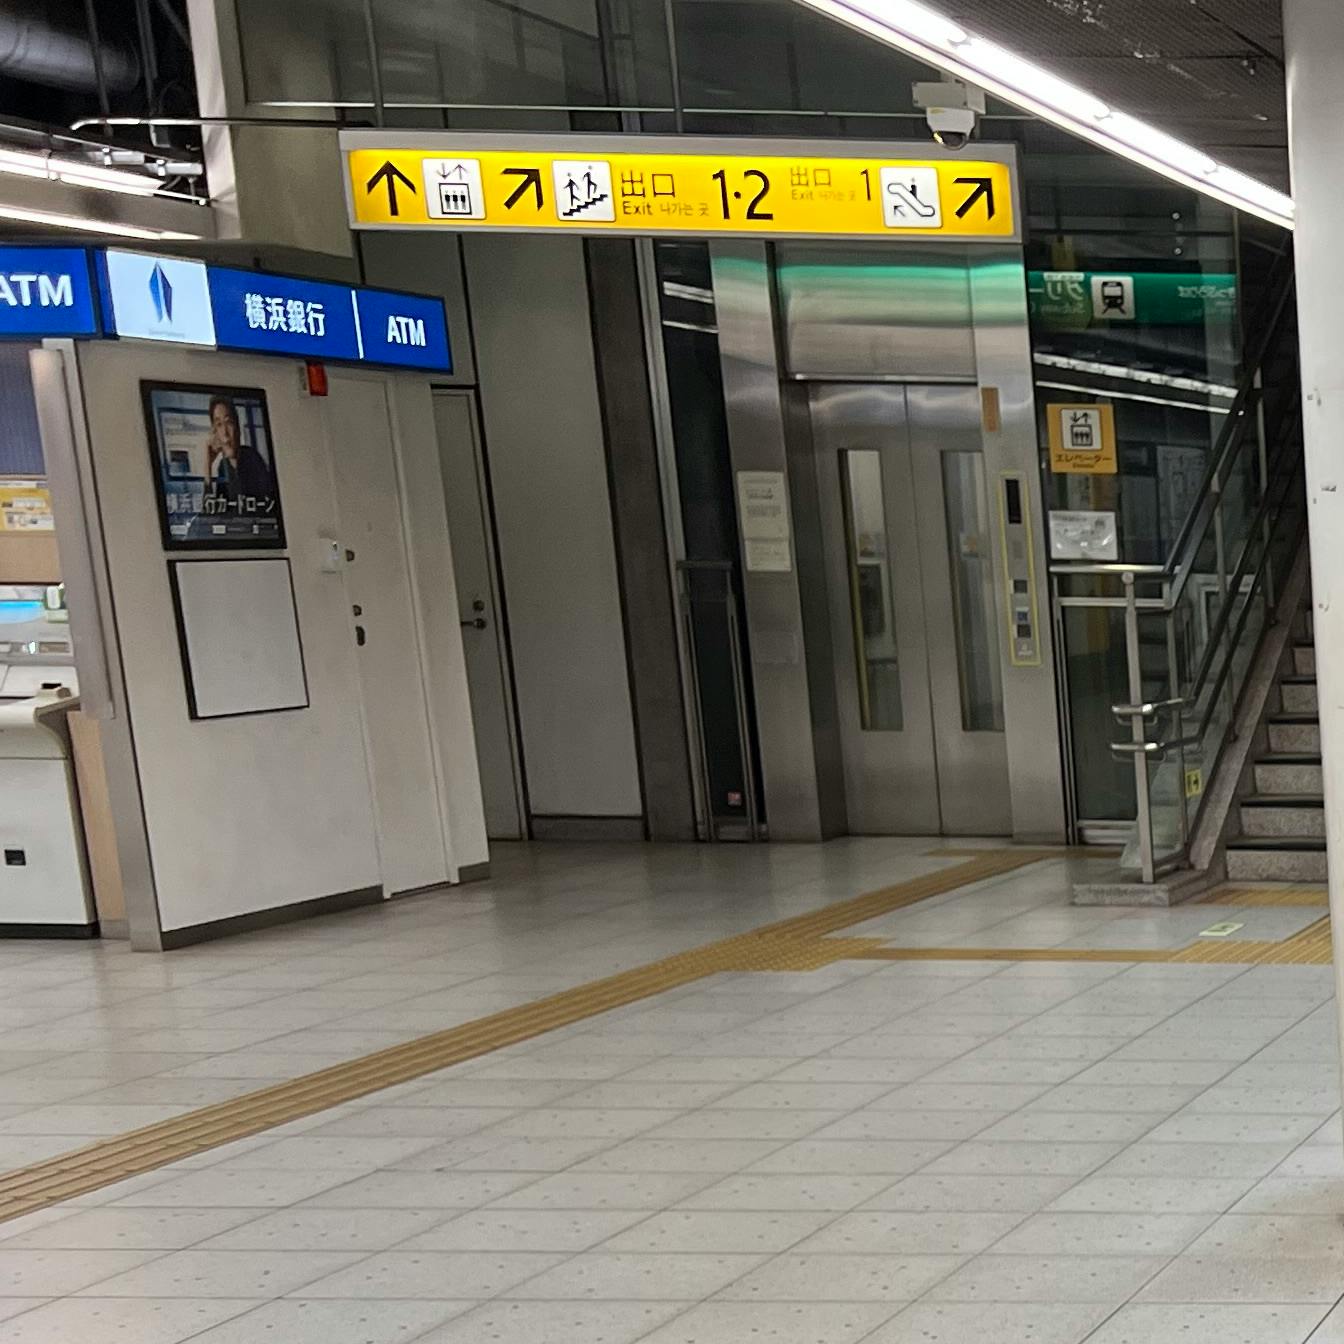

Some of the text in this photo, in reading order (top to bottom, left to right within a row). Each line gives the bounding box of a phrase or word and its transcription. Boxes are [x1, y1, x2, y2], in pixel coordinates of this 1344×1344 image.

[621, 169, 676, 198] 出口
[790, 166, 871, 201] 出口 1
[623, 200, 653, 216] Exit
[0, 273, 74, 307] ATM
[245, 292, 426, 347] 横浜銀行 ATM
